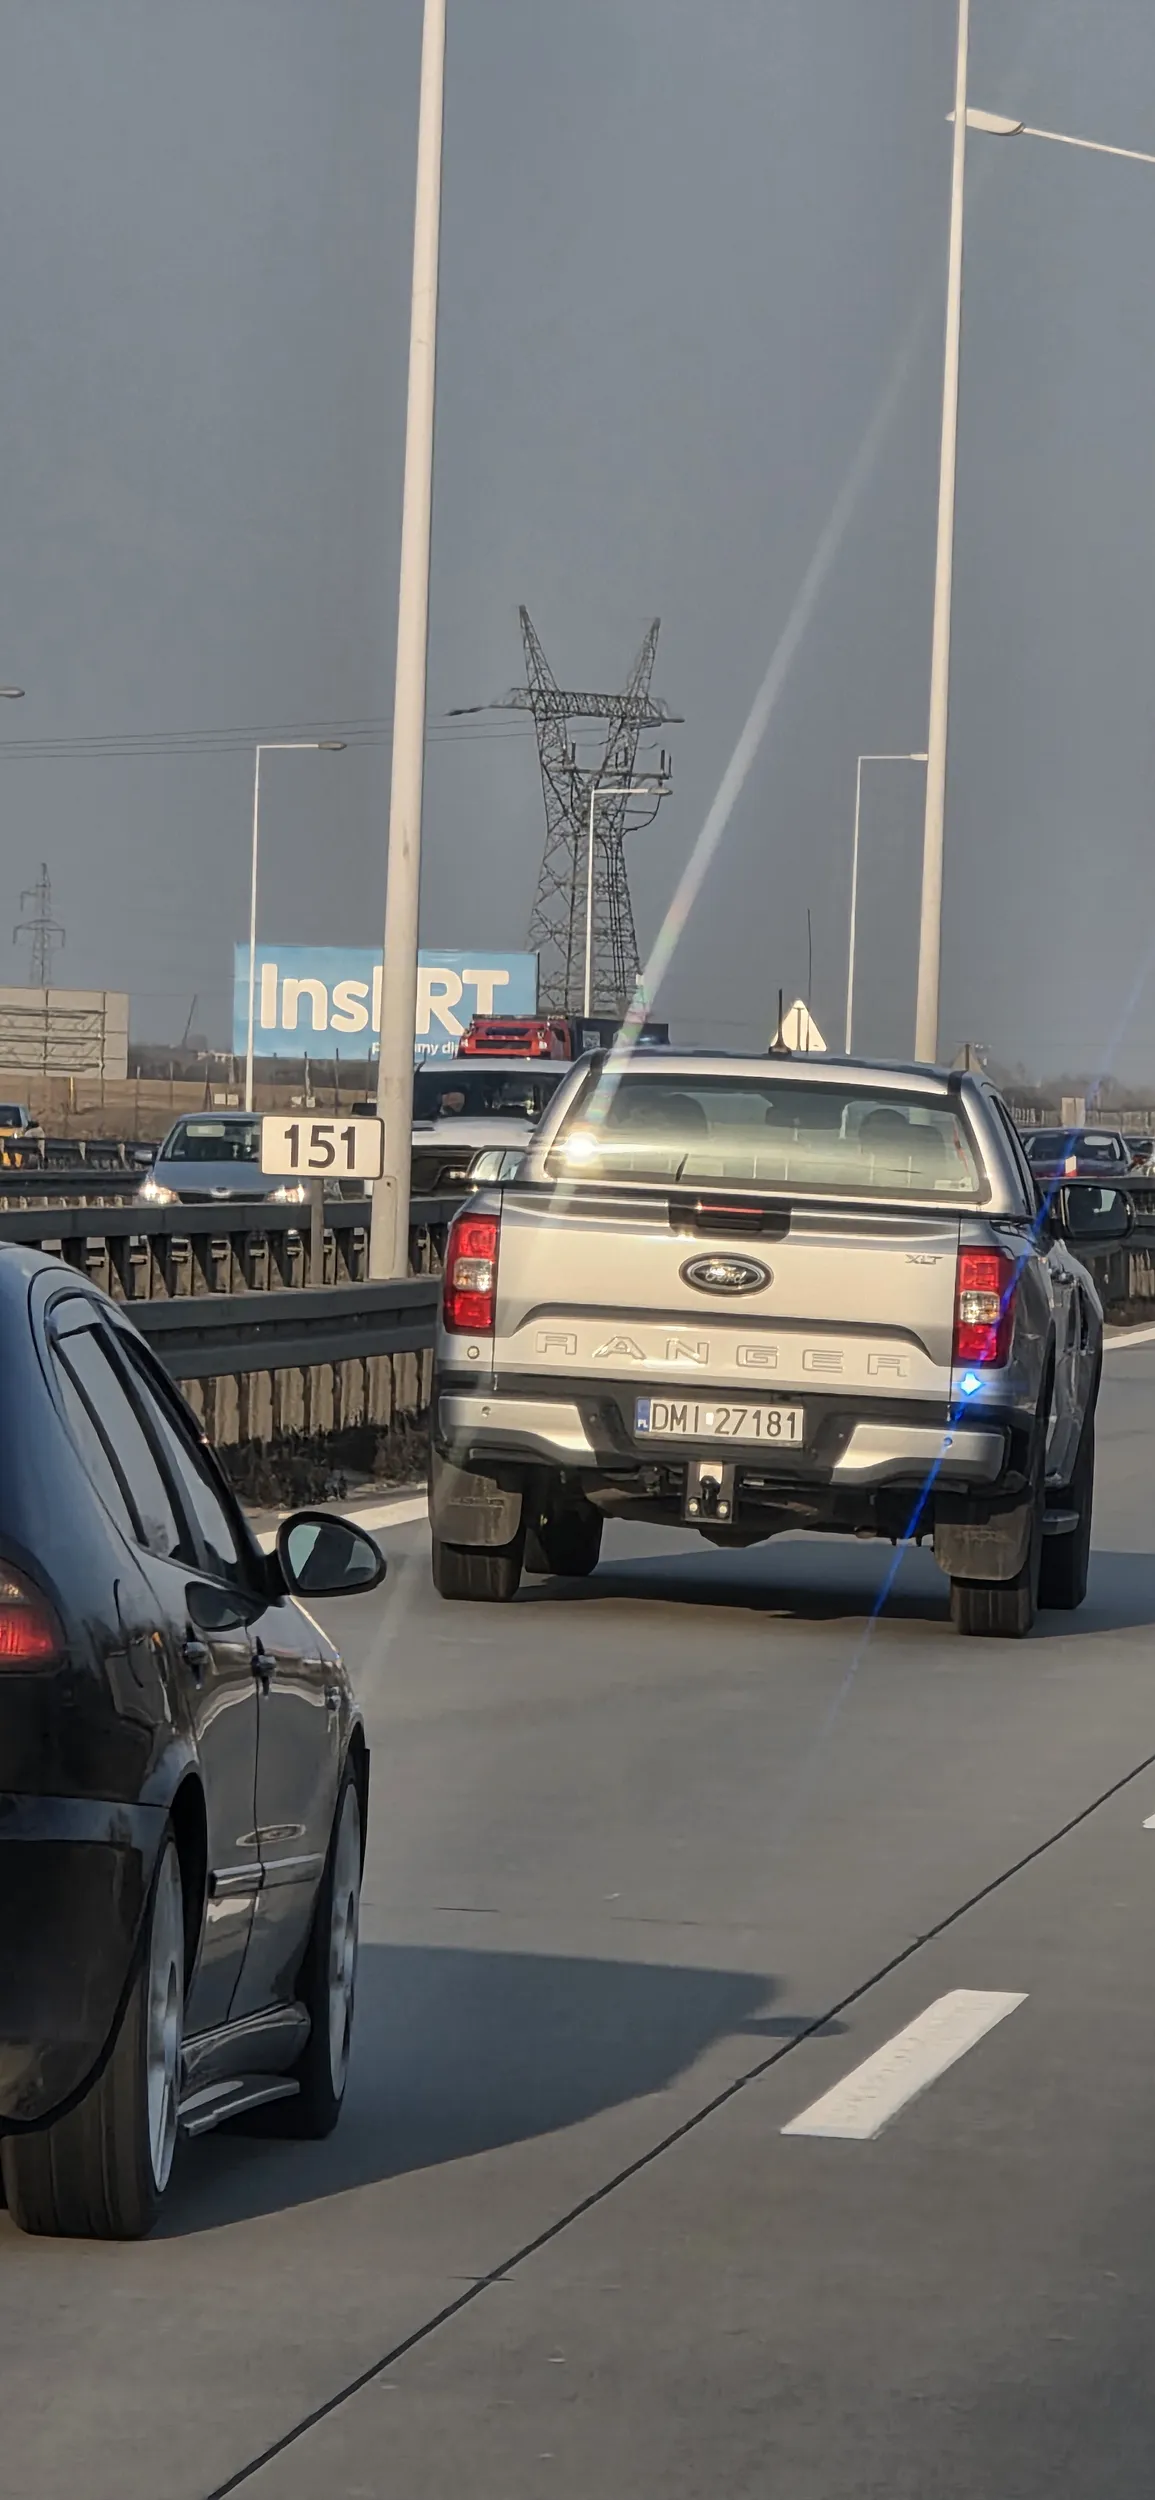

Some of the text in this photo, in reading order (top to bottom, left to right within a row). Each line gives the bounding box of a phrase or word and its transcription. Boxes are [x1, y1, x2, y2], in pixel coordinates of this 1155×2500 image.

[261, 963, 510, 1036] InsRT
[284, 1124, 356, 1170] 151
[703, 1263, 748, 1285] Ford
[904, 1253, 944, 1266] XLT
[534, 1330, 910, 1378] RANGER
[651, 1403, 796, 1440] DMI 27181
